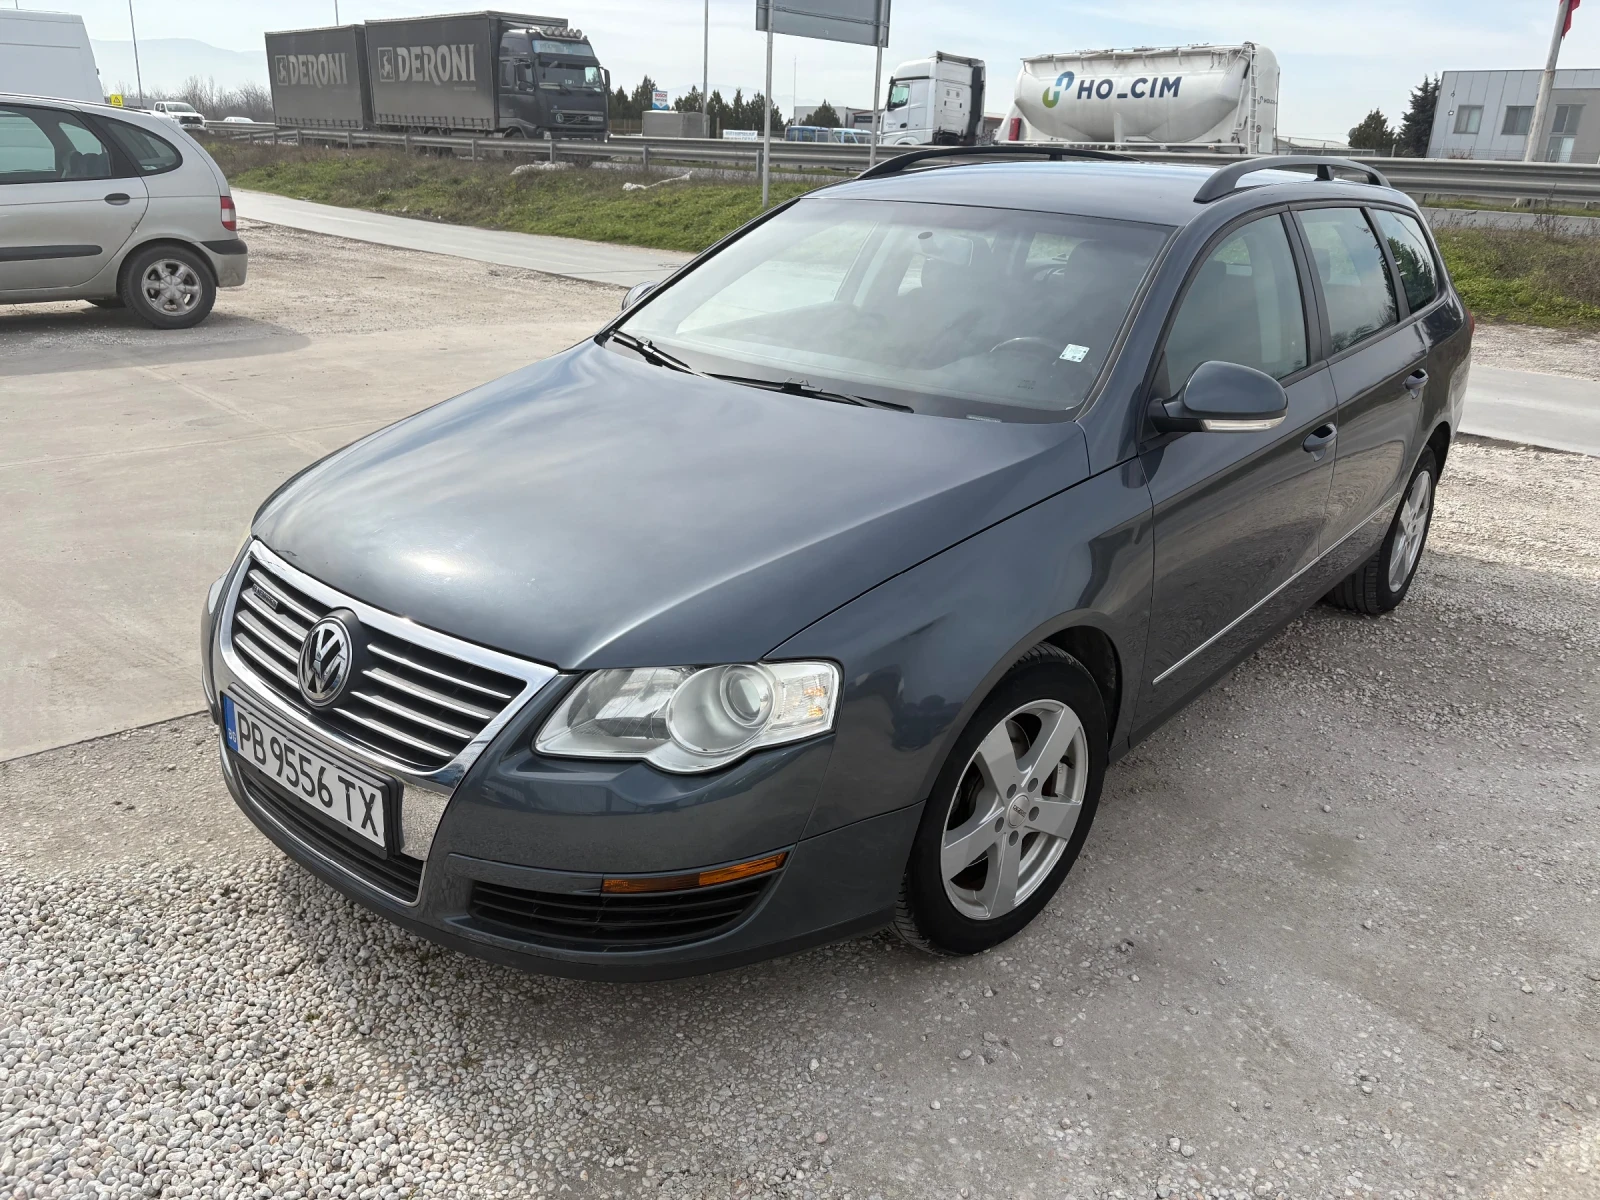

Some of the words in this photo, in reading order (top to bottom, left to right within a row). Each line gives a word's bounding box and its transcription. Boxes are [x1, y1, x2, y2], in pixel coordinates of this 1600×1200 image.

[288, 53, 348, 88] DERONI
[396, 44, 476, 86] DERONI
[228, 727, 237, 742] BG
[237, 711, 266, 766] PB
[269, 736, 333, 808] 9556
[338, 774, 379, 837] TX
